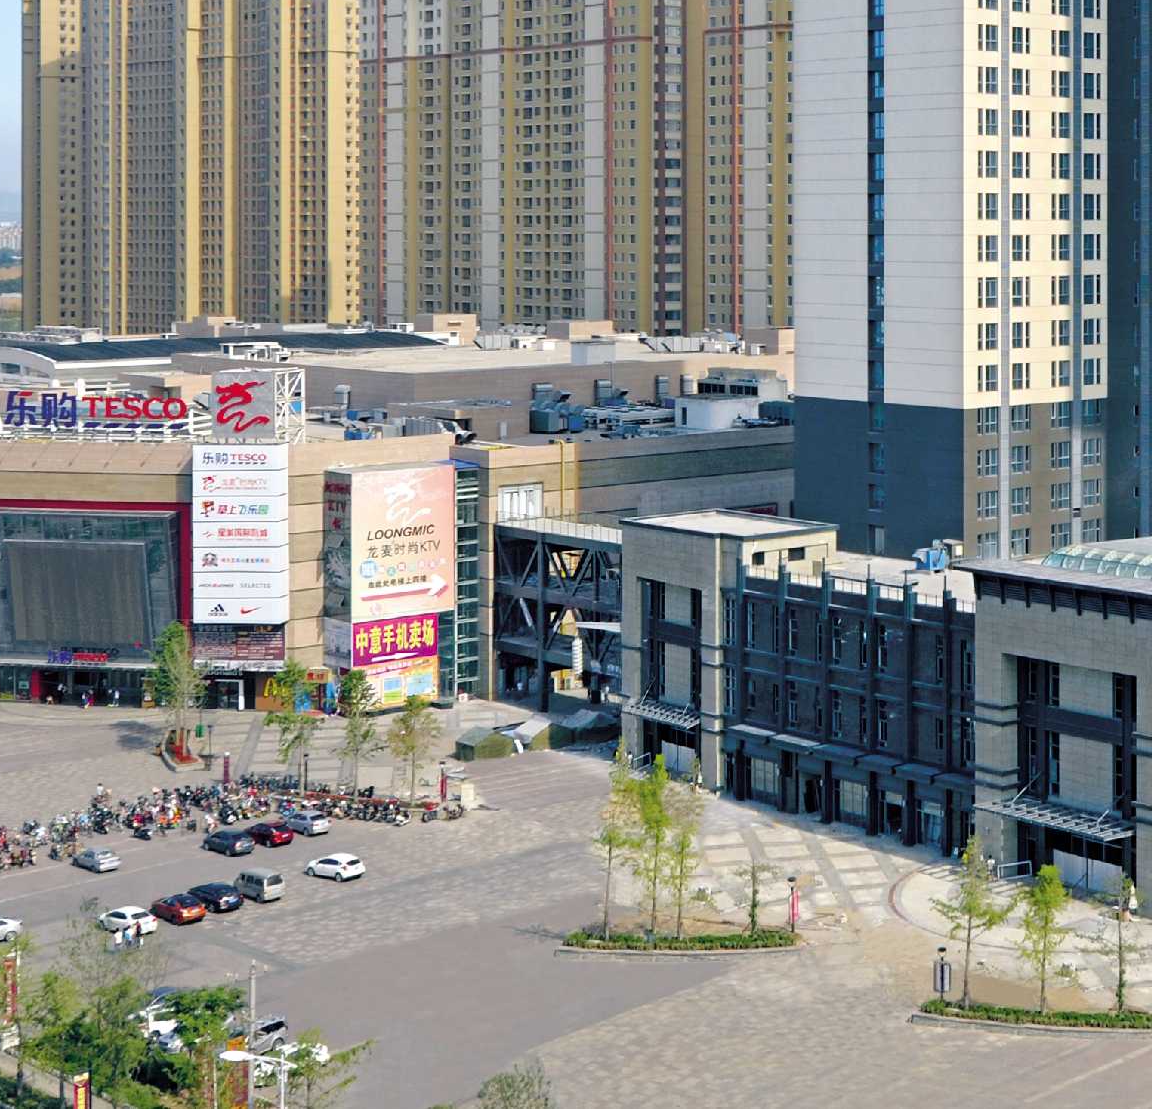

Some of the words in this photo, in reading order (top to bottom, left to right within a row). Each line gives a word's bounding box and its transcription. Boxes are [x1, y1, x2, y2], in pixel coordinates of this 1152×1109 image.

[4, 390, 77, 428] 乐购
[81, 395, 188, 421] TESCO
[230, 453, 267, 462] TESCO
[367, 523, 435, 541] LOONGMIC
[354, 619, 435, 657] 中意手机卖场
